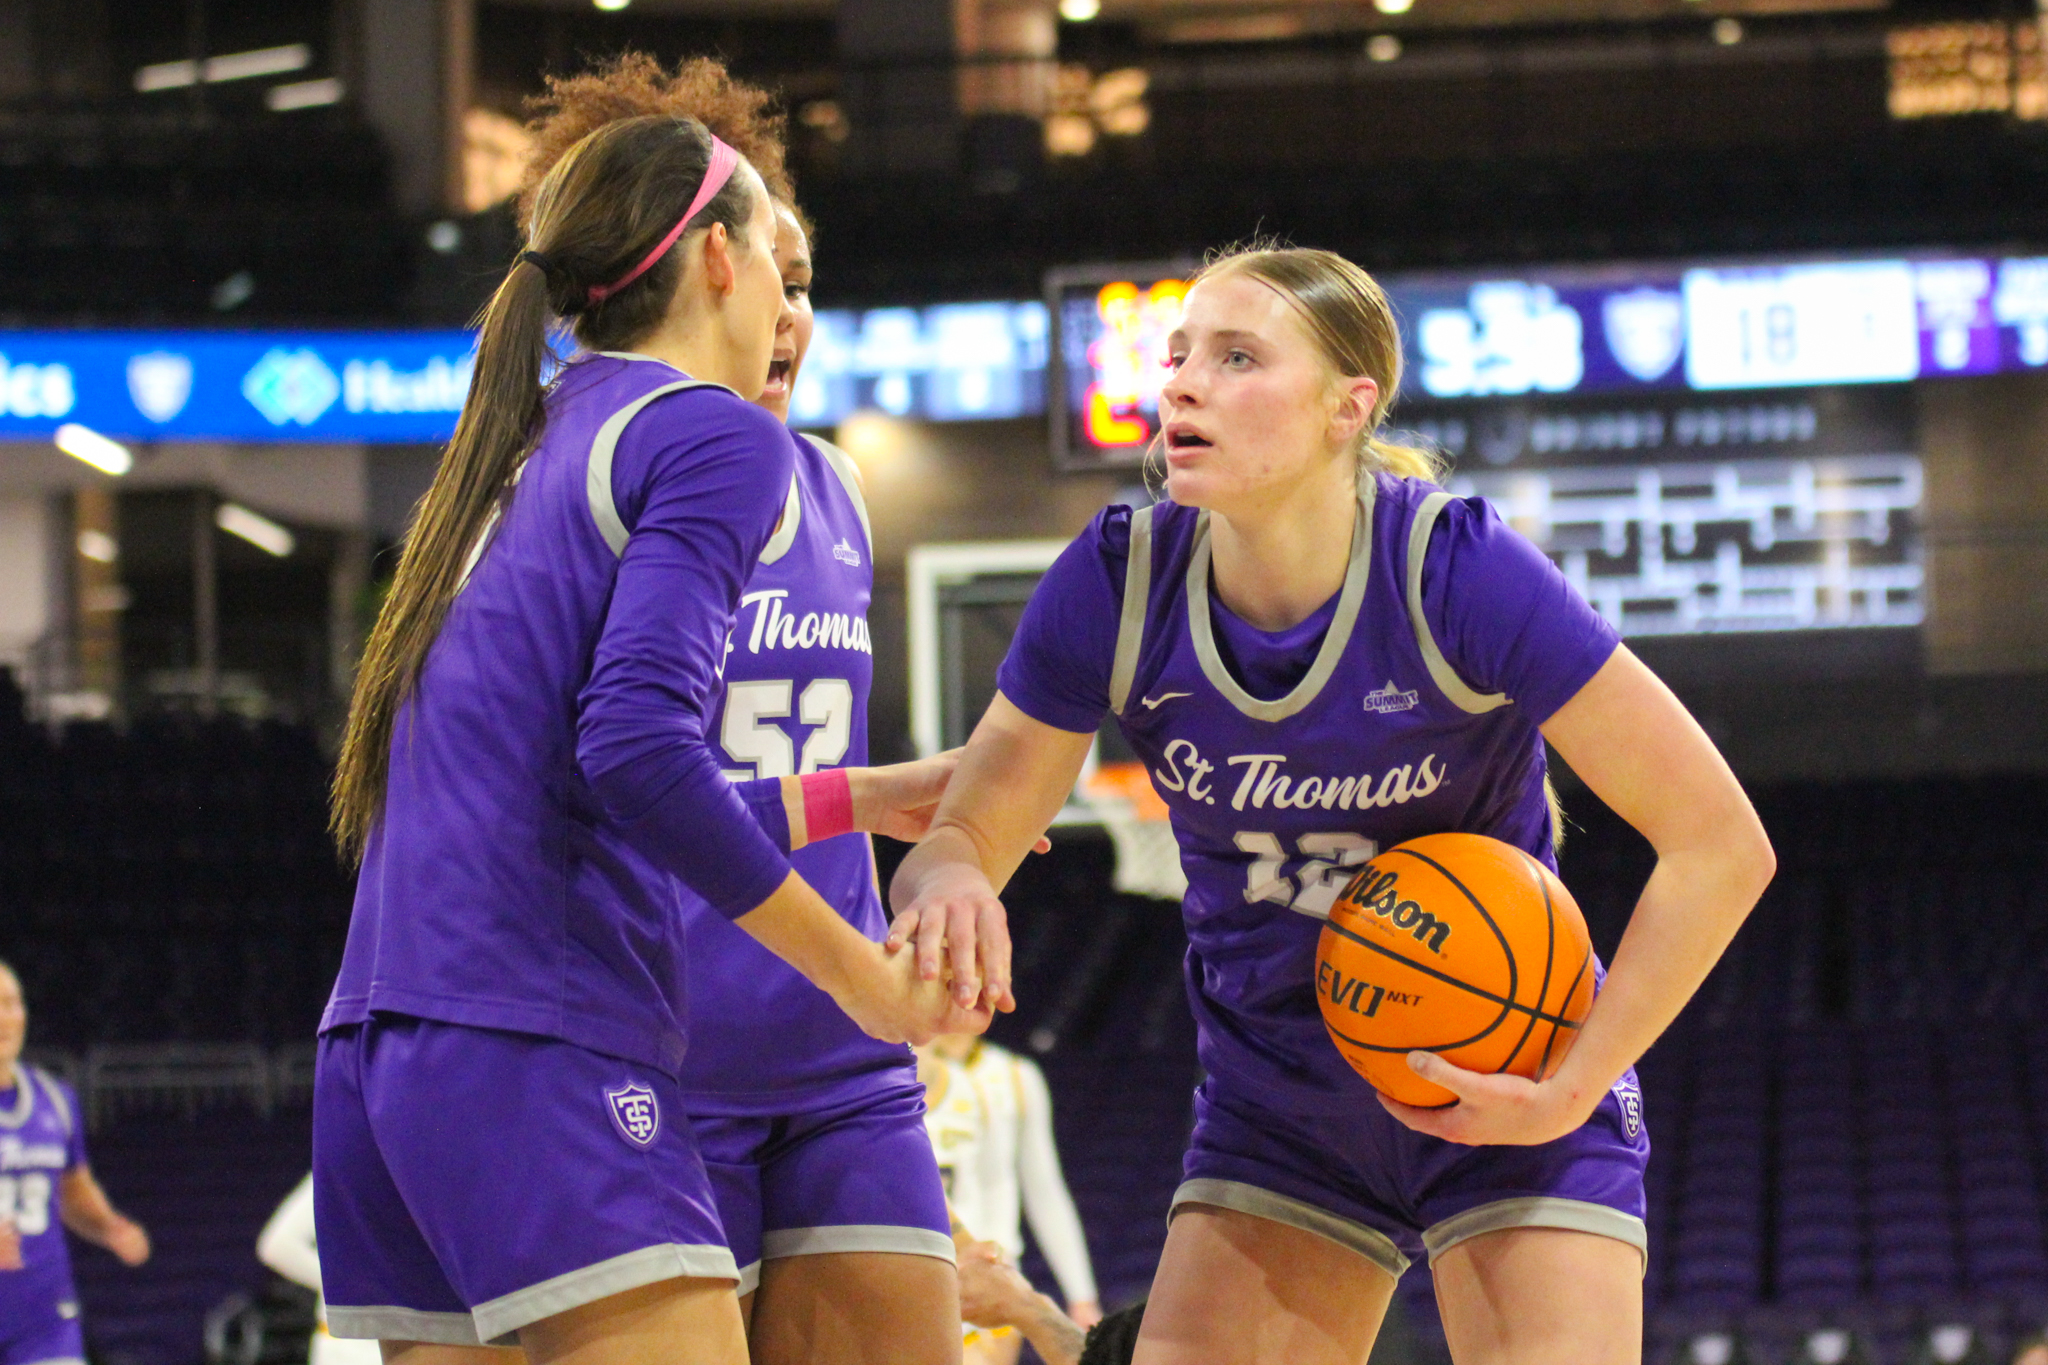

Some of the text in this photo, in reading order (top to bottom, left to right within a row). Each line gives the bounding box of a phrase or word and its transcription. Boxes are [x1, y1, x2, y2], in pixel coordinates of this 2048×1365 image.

[719, 677, 853, 782] 52
[1365, 692, 1418, 709] SUMMIT
[1155, 738, 1216, 806] St.
[1227, 753, 1447, 812] Thomas
[1232, 831, 1379, 921] 12
[1387, 990, 1423, 1007] NXT
